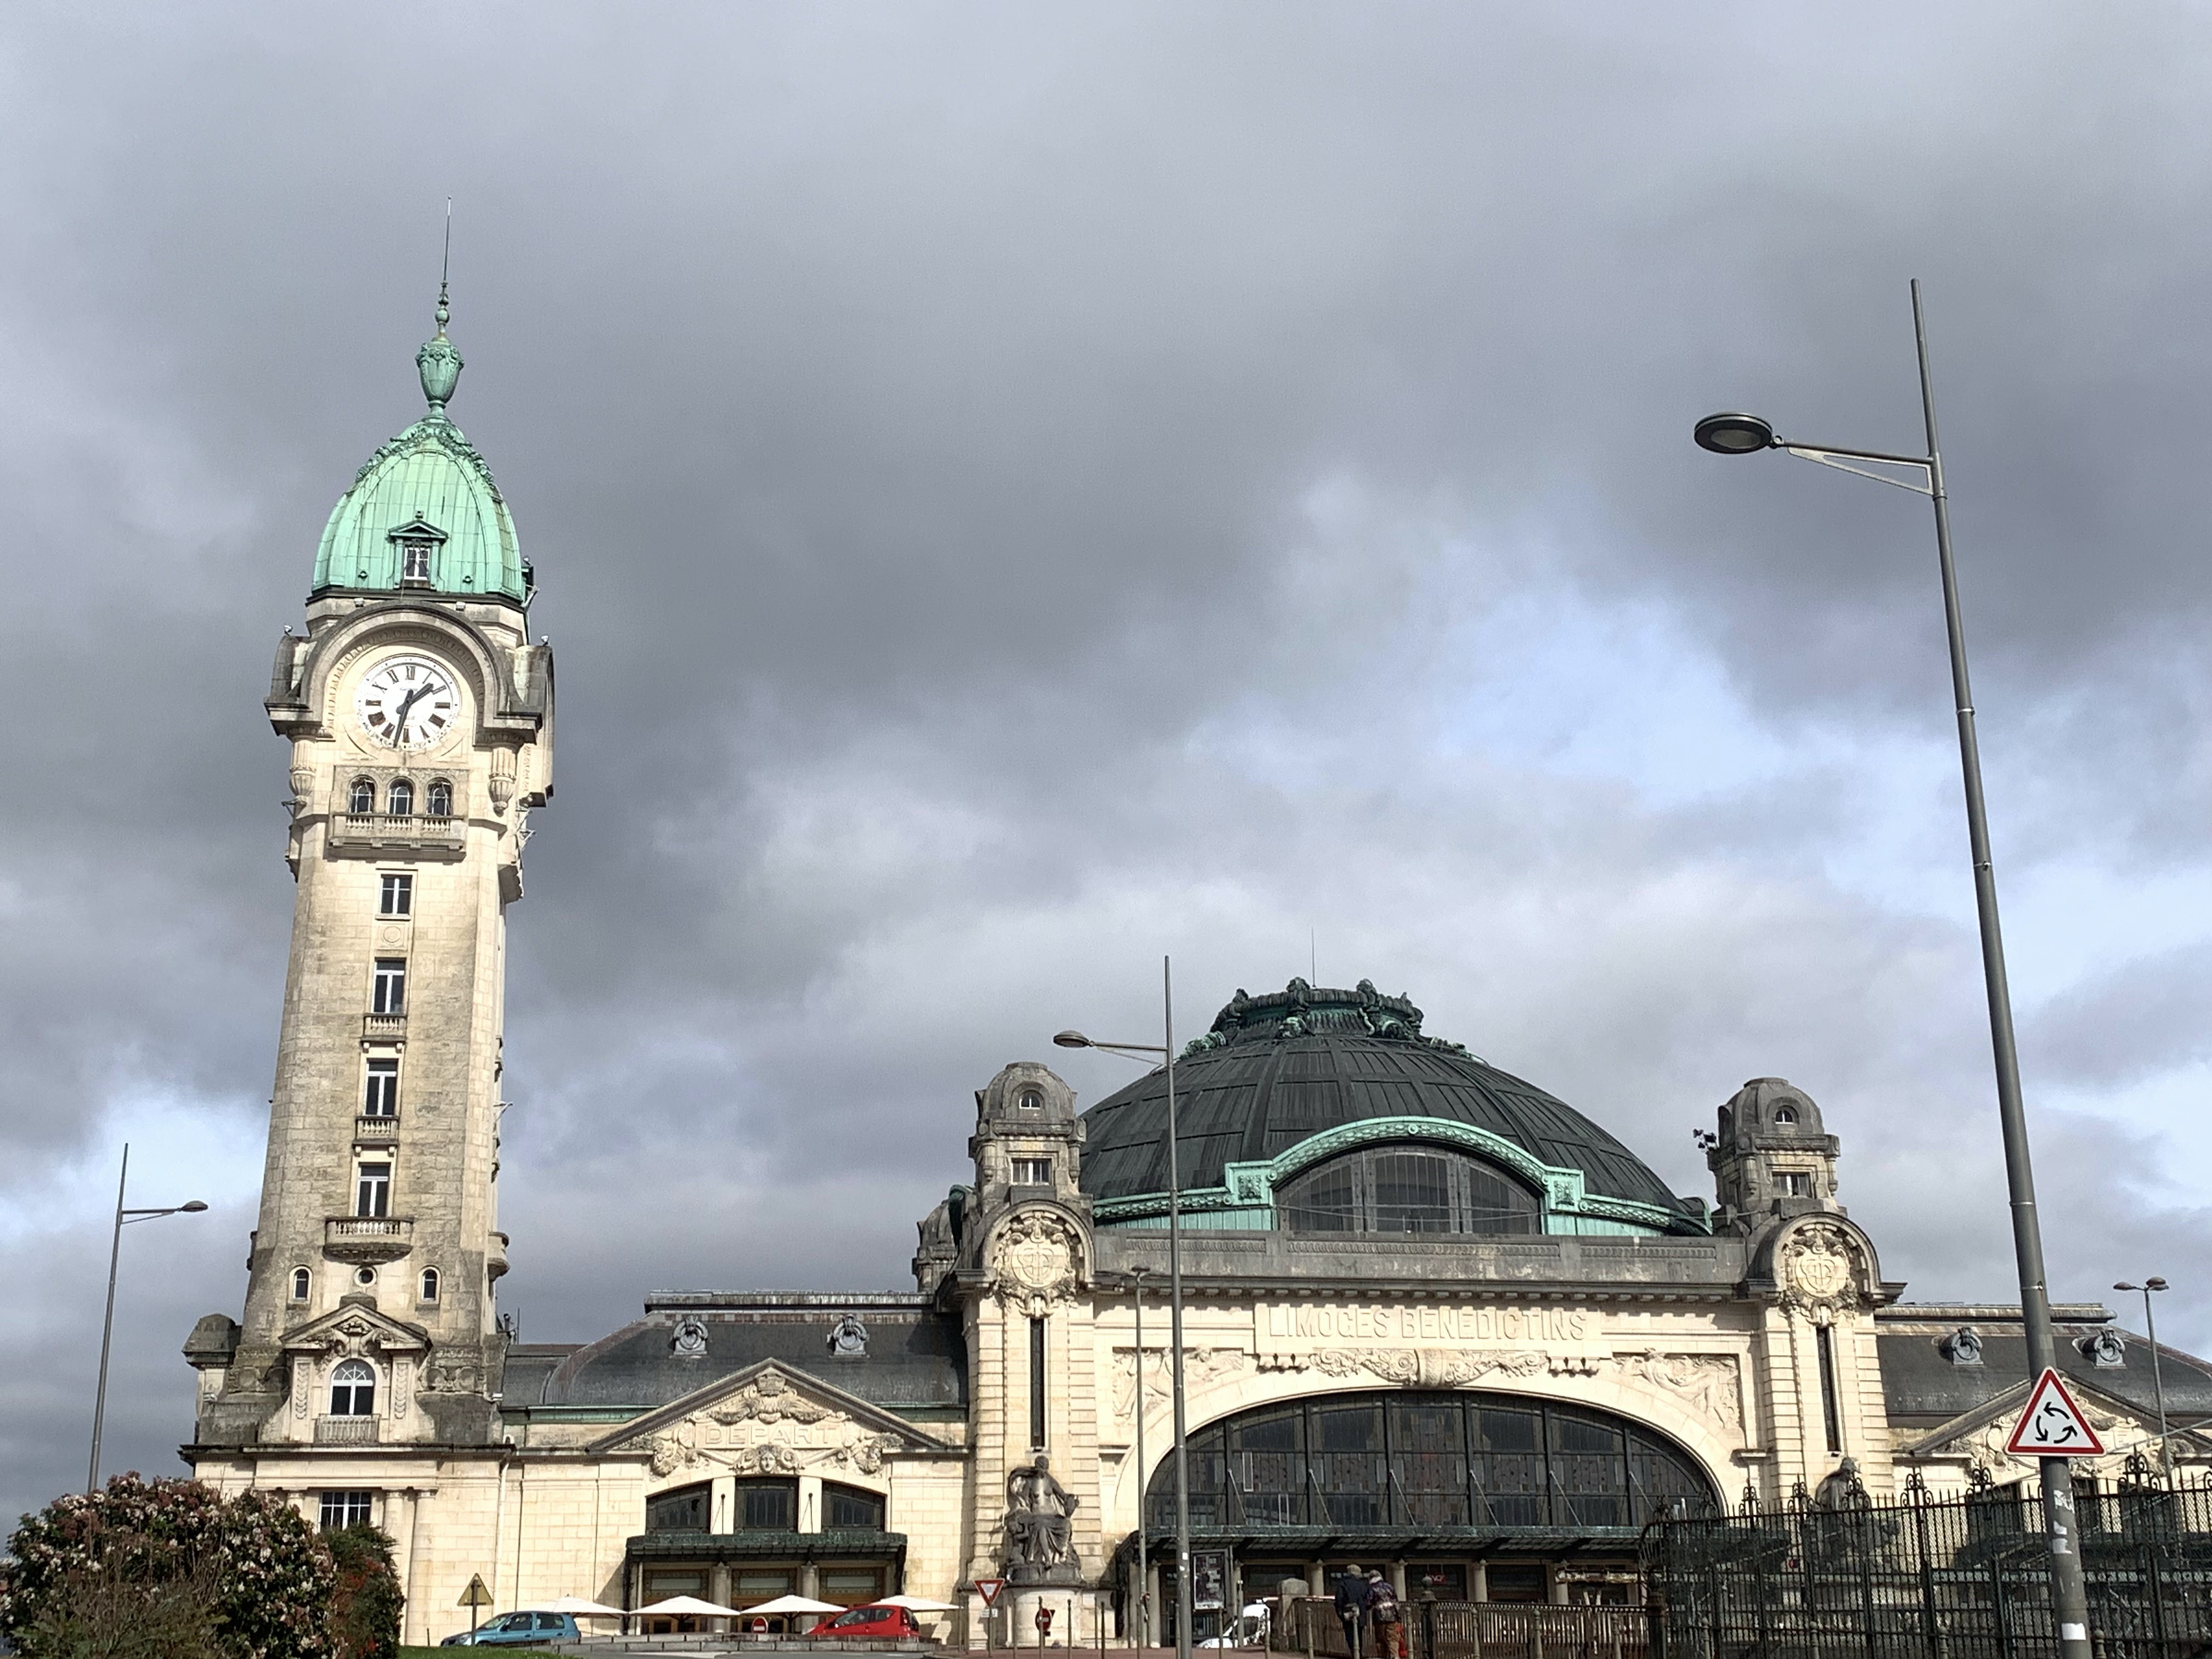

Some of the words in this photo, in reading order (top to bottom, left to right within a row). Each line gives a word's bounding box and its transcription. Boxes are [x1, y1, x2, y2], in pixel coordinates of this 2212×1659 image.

[1268, 1307, 1390, 1338] LIMOGES
[1400, 1308, 1587, 1340] BENEDICTINS
[705, 1425, 837, 1444] DEPART
